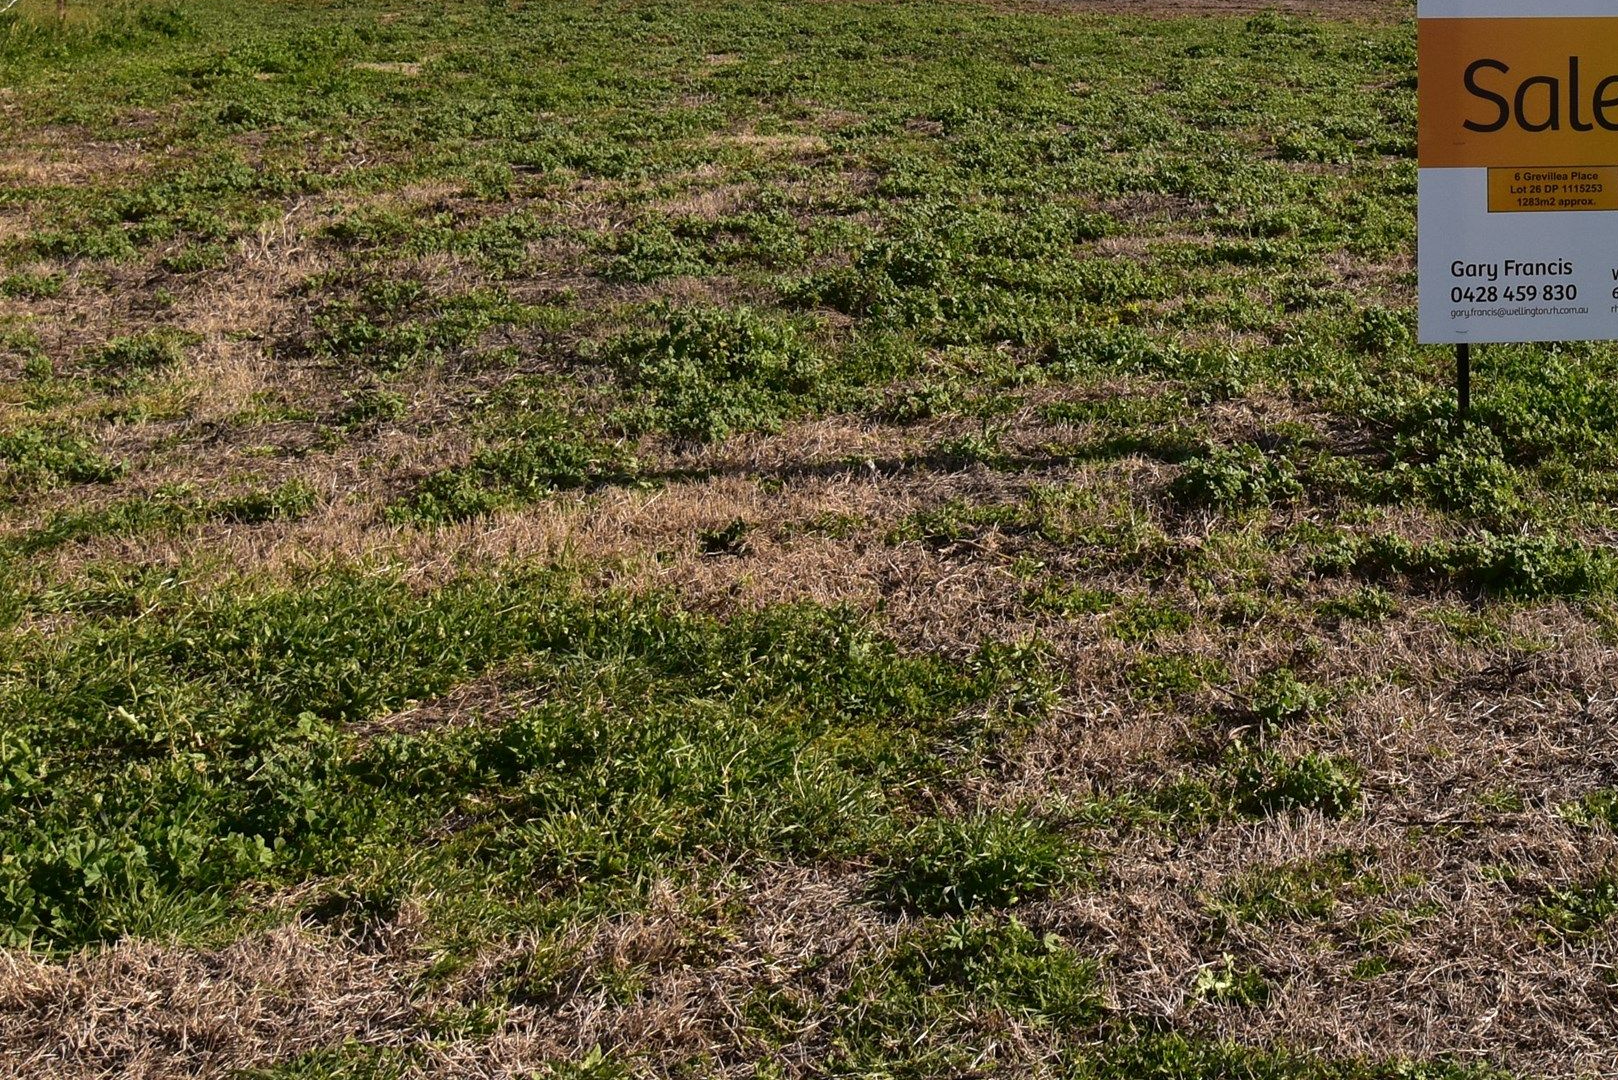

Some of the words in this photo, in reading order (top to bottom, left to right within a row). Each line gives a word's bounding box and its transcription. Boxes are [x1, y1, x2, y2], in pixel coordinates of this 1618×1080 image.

[1523, 172, 1568, 181] Grevillea
[1571, 171, 1599, 180] Place
[1510, 184, 1526, 194] Lot
[1544, 184, 1559, 193] DP
[1562, 183, 1603, 193] 1115253
[1517, 197, 1556, 207] 1283m2
[1558, 197, 1596, 208] approx.
[1450, 260, 1498, 281] Gary
[1504, 257, 1573, 277] Francis
[1450, 286, 1498, 303] 0428
[1502, 285, 1537, 302] 459
[1542, 284, 1578, 301] 830
[1450, 306, 1589, 319] gary.francis@wellington.rh.com.au
